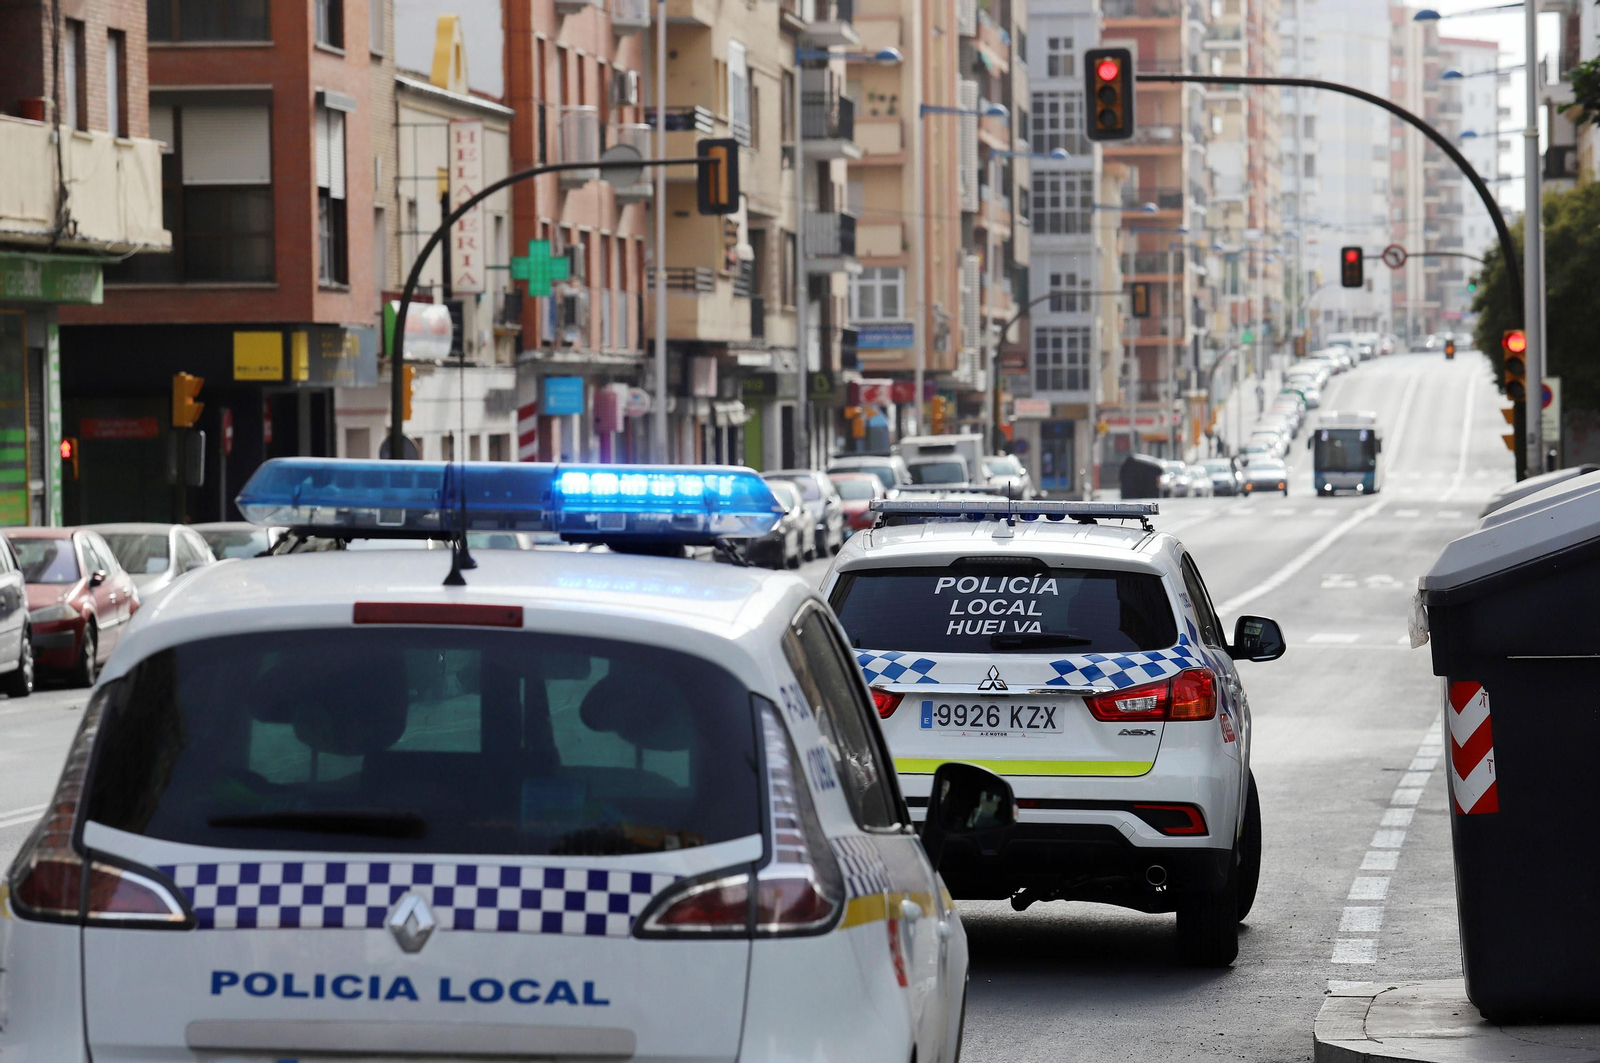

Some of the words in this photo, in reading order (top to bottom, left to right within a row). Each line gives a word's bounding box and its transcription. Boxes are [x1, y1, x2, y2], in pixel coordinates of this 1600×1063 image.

[934, 573, 1059, 596] POLICÍA
[949, 599, 1043, 616] LOCAL
[937, 704, 1000, 728] 9926
[1010, 705, 1057, 729] KZX
[1117, 728, 1157, 737] ASX
[209, 970, 419, 1001] POLICIA
[439, 977, 611, 1007] LOCAL
